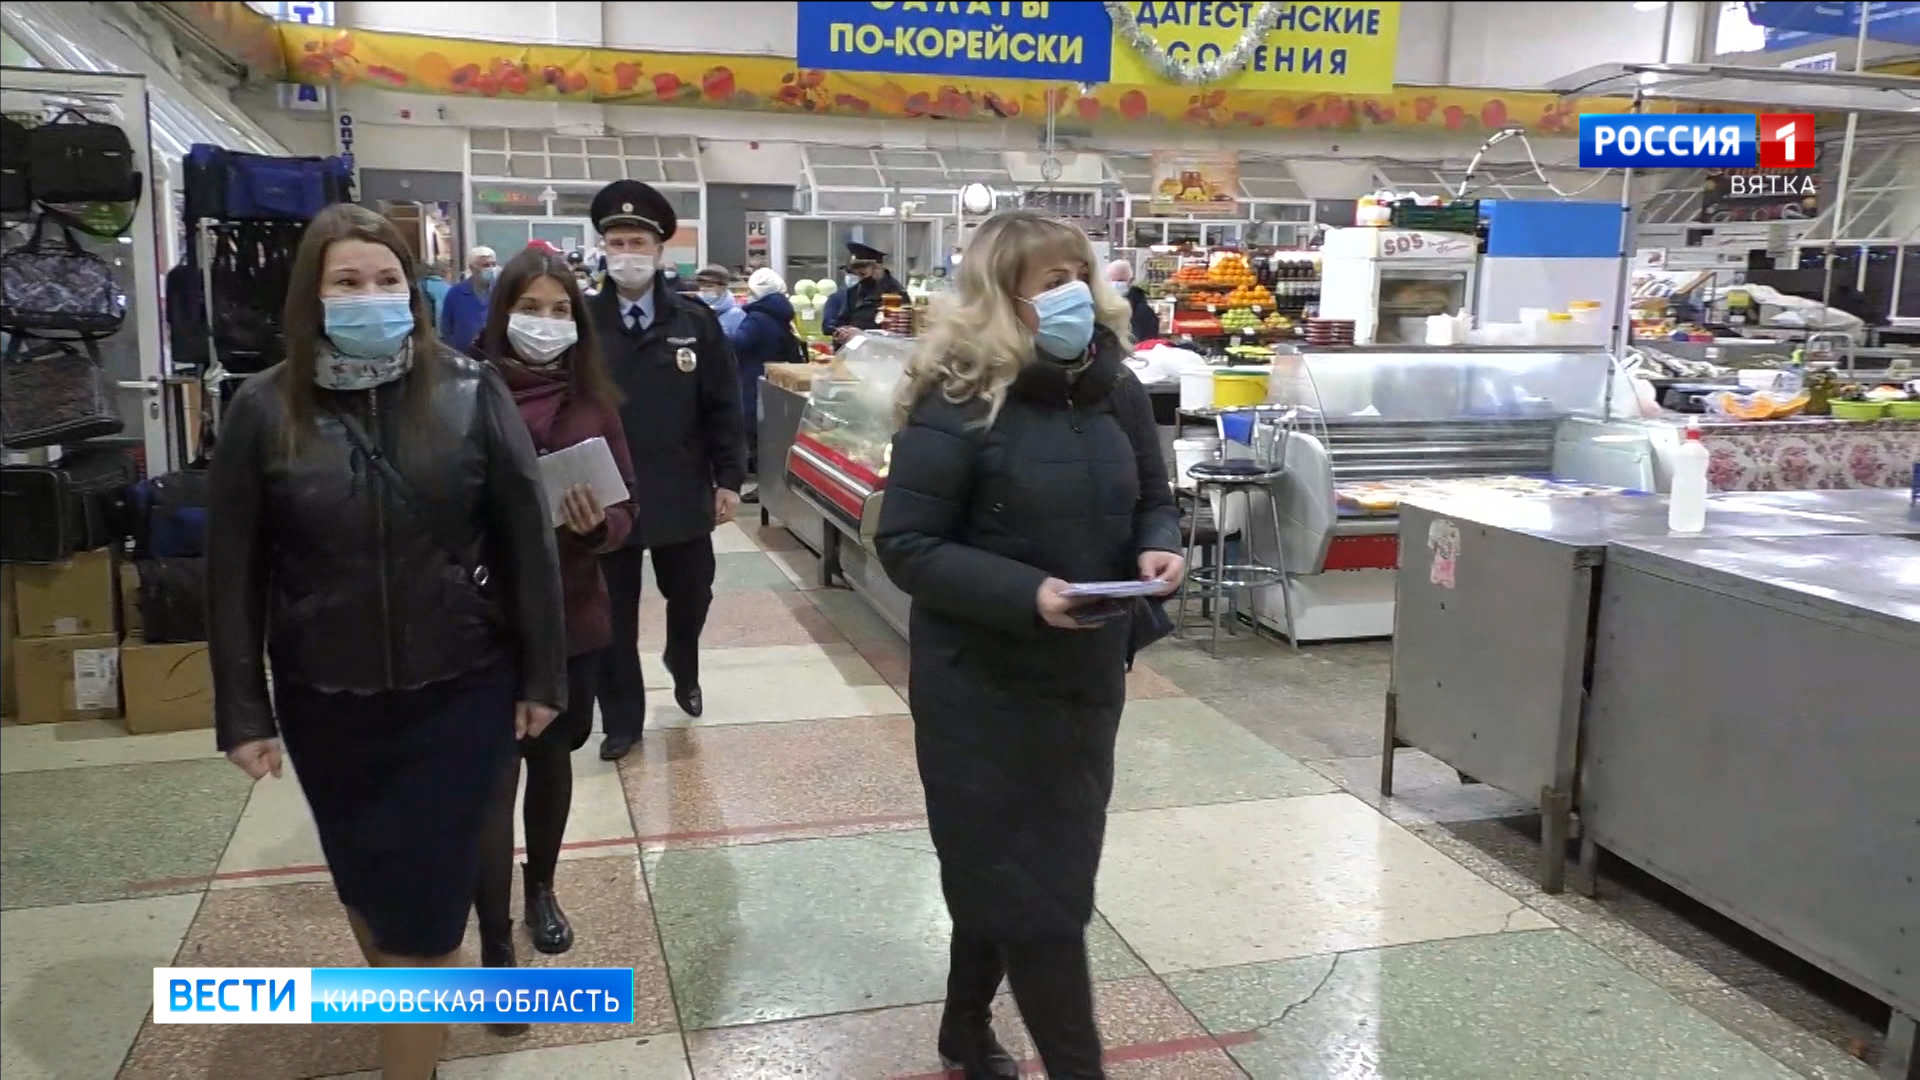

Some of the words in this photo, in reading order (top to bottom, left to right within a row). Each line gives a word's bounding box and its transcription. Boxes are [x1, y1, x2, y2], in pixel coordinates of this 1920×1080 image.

[871, 2, 1049, 19] АТЫ
[1136, 2, 1380, 35] ДАГЕСТНСКИЕ
[829, 23, 1083, 64] ПО-КОРЕЙСКИ
[1166, 41, 1347, 75] СОЕНИЯ
